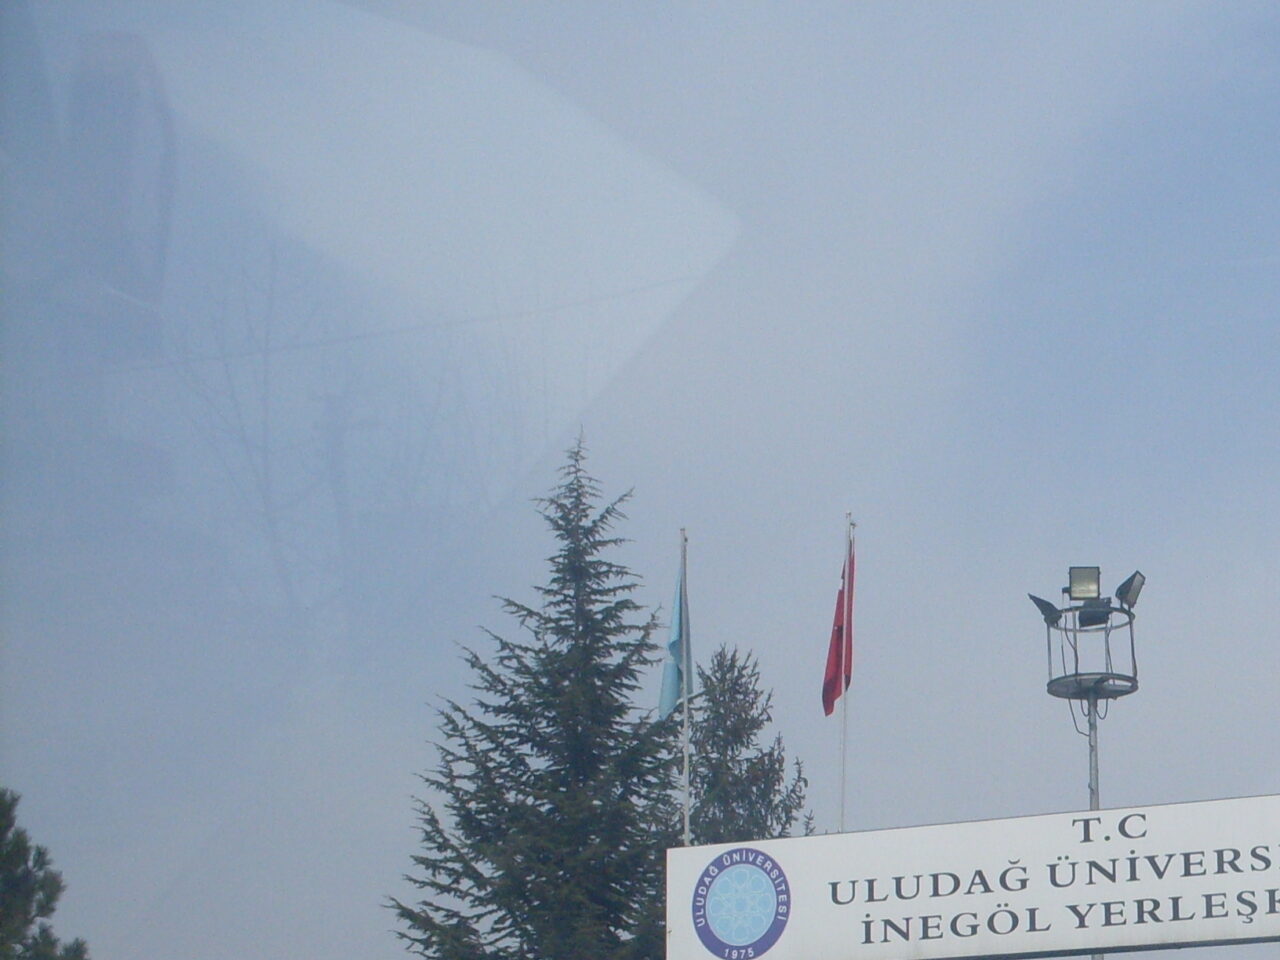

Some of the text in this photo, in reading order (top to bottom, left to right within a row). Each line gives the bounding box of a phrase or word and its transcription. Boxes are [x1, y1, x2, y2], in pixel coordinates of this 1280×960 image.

[1072, 813, 1148, 843] T.C
[828, 859, 1030, 906] ULUDAĞ
[861, 903, 1052, 945] İNEGÖL
[724, 947, 754, 960] 1975
